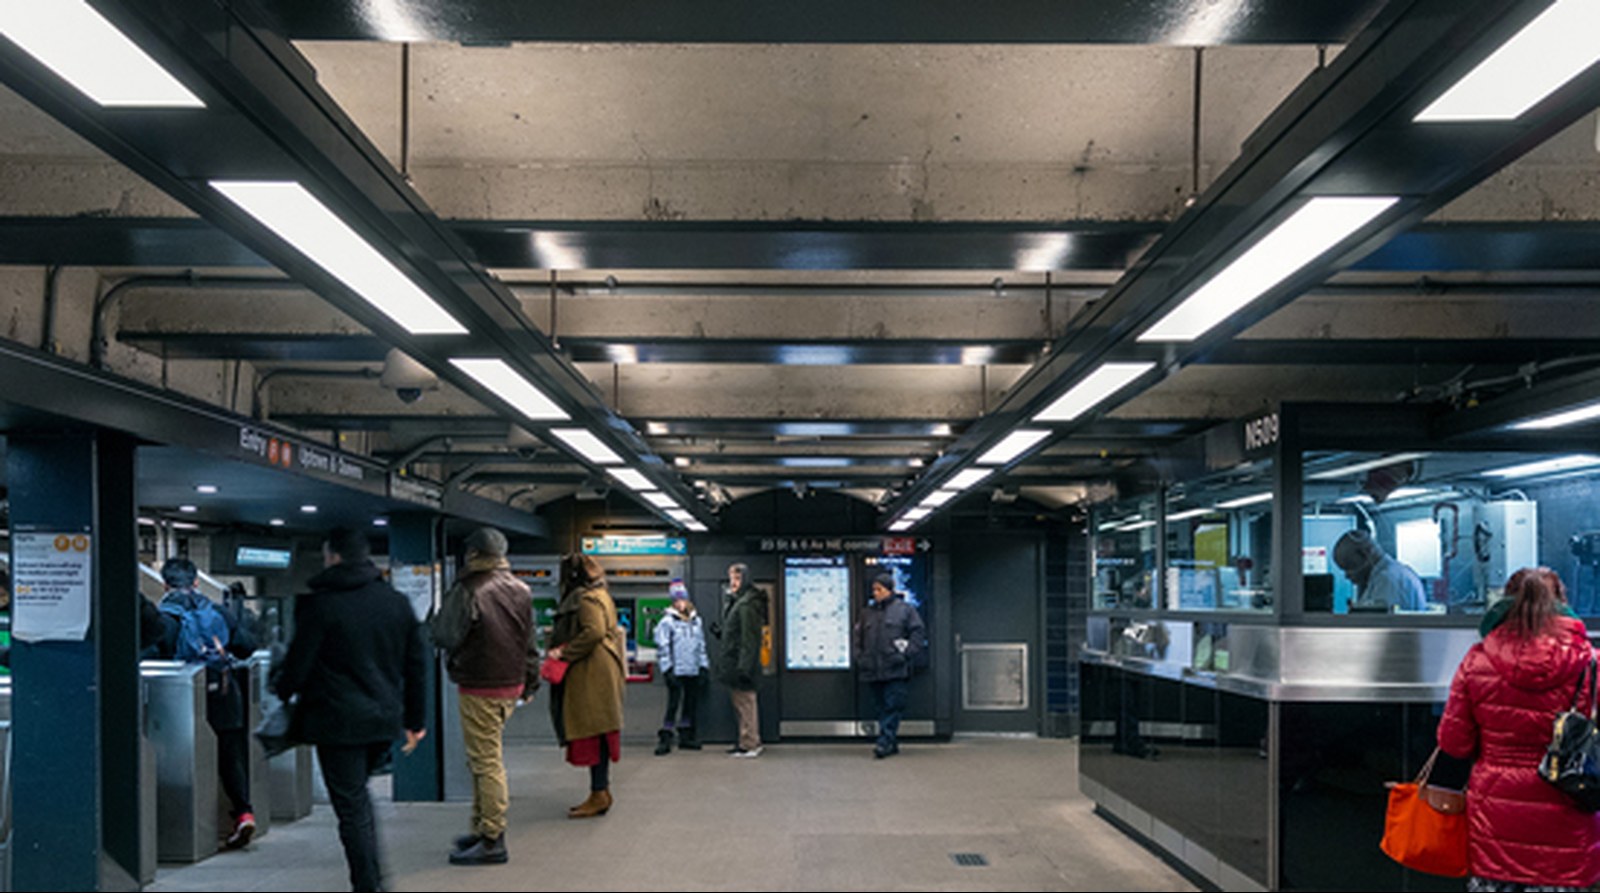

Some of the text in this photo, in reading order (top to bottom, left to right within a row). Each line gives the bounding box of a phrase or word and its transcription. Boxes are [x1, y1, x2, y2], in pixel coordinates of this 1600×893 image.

[240, 427, 267, 458] Entry
[299, 445, 328, 470] Uptown
[844, 541, 880, 550] corner
